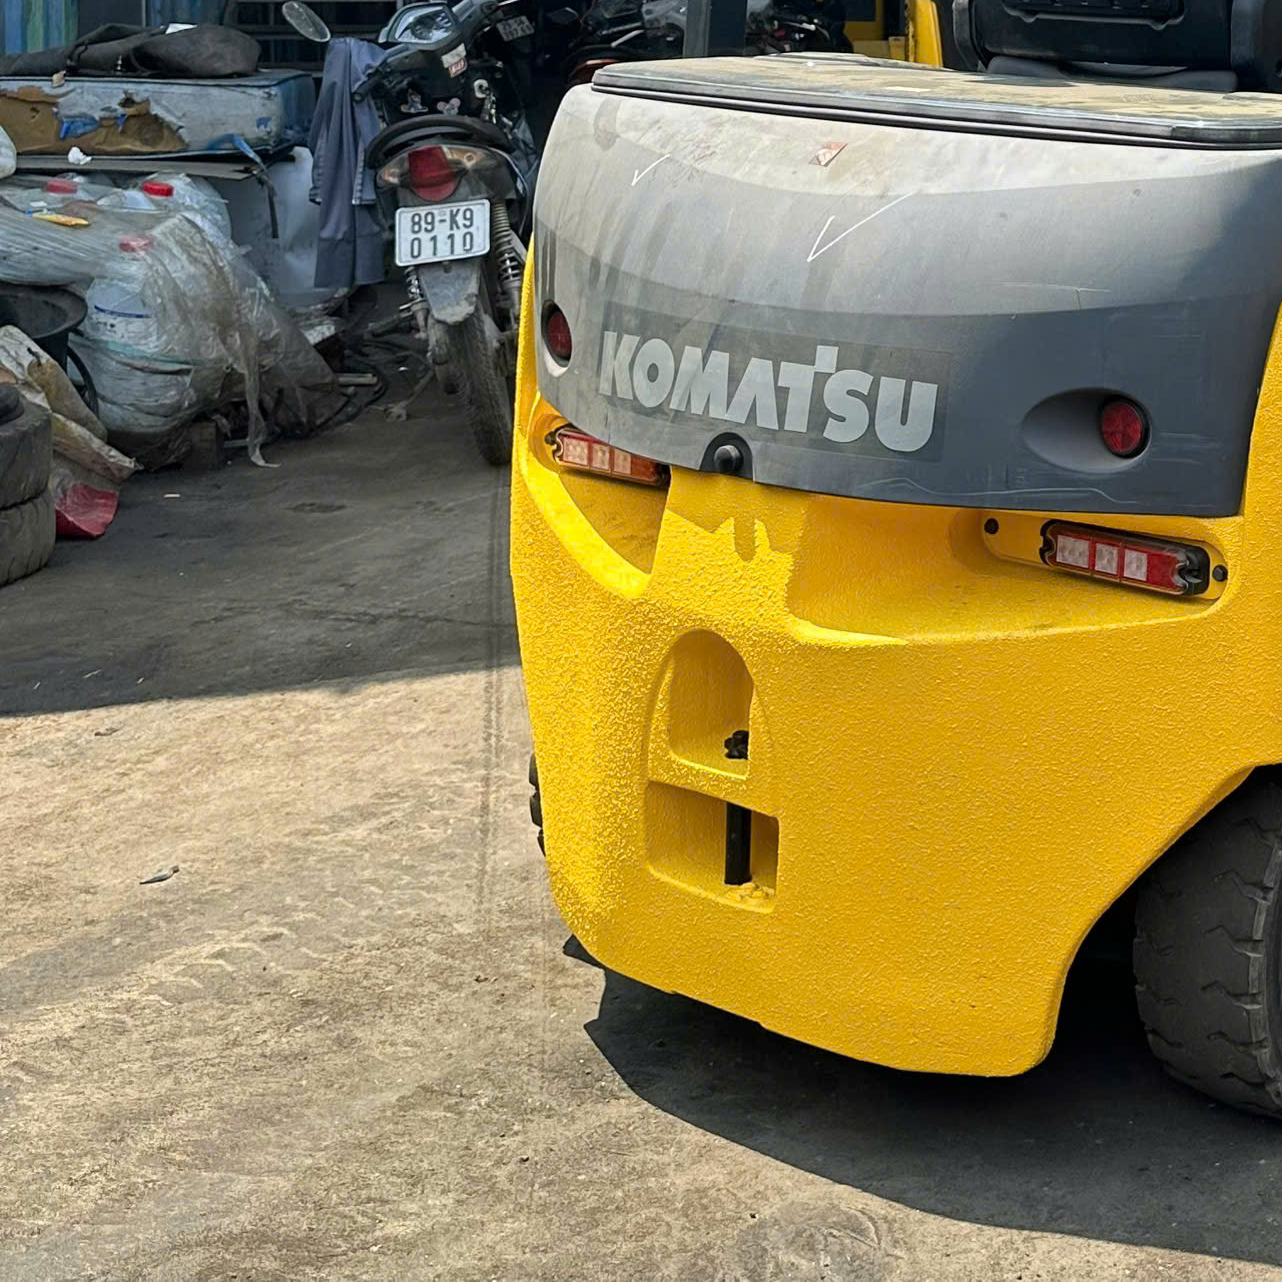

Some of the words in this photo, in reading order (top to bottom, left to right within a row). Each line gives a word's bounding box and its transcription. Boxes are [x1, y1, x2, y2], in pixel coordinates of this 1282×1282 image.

[410, 207, 474, 234] 89-K9
[410, 231, 474, 259] 0110
[600, 329, 939, 453] KOMATSU
